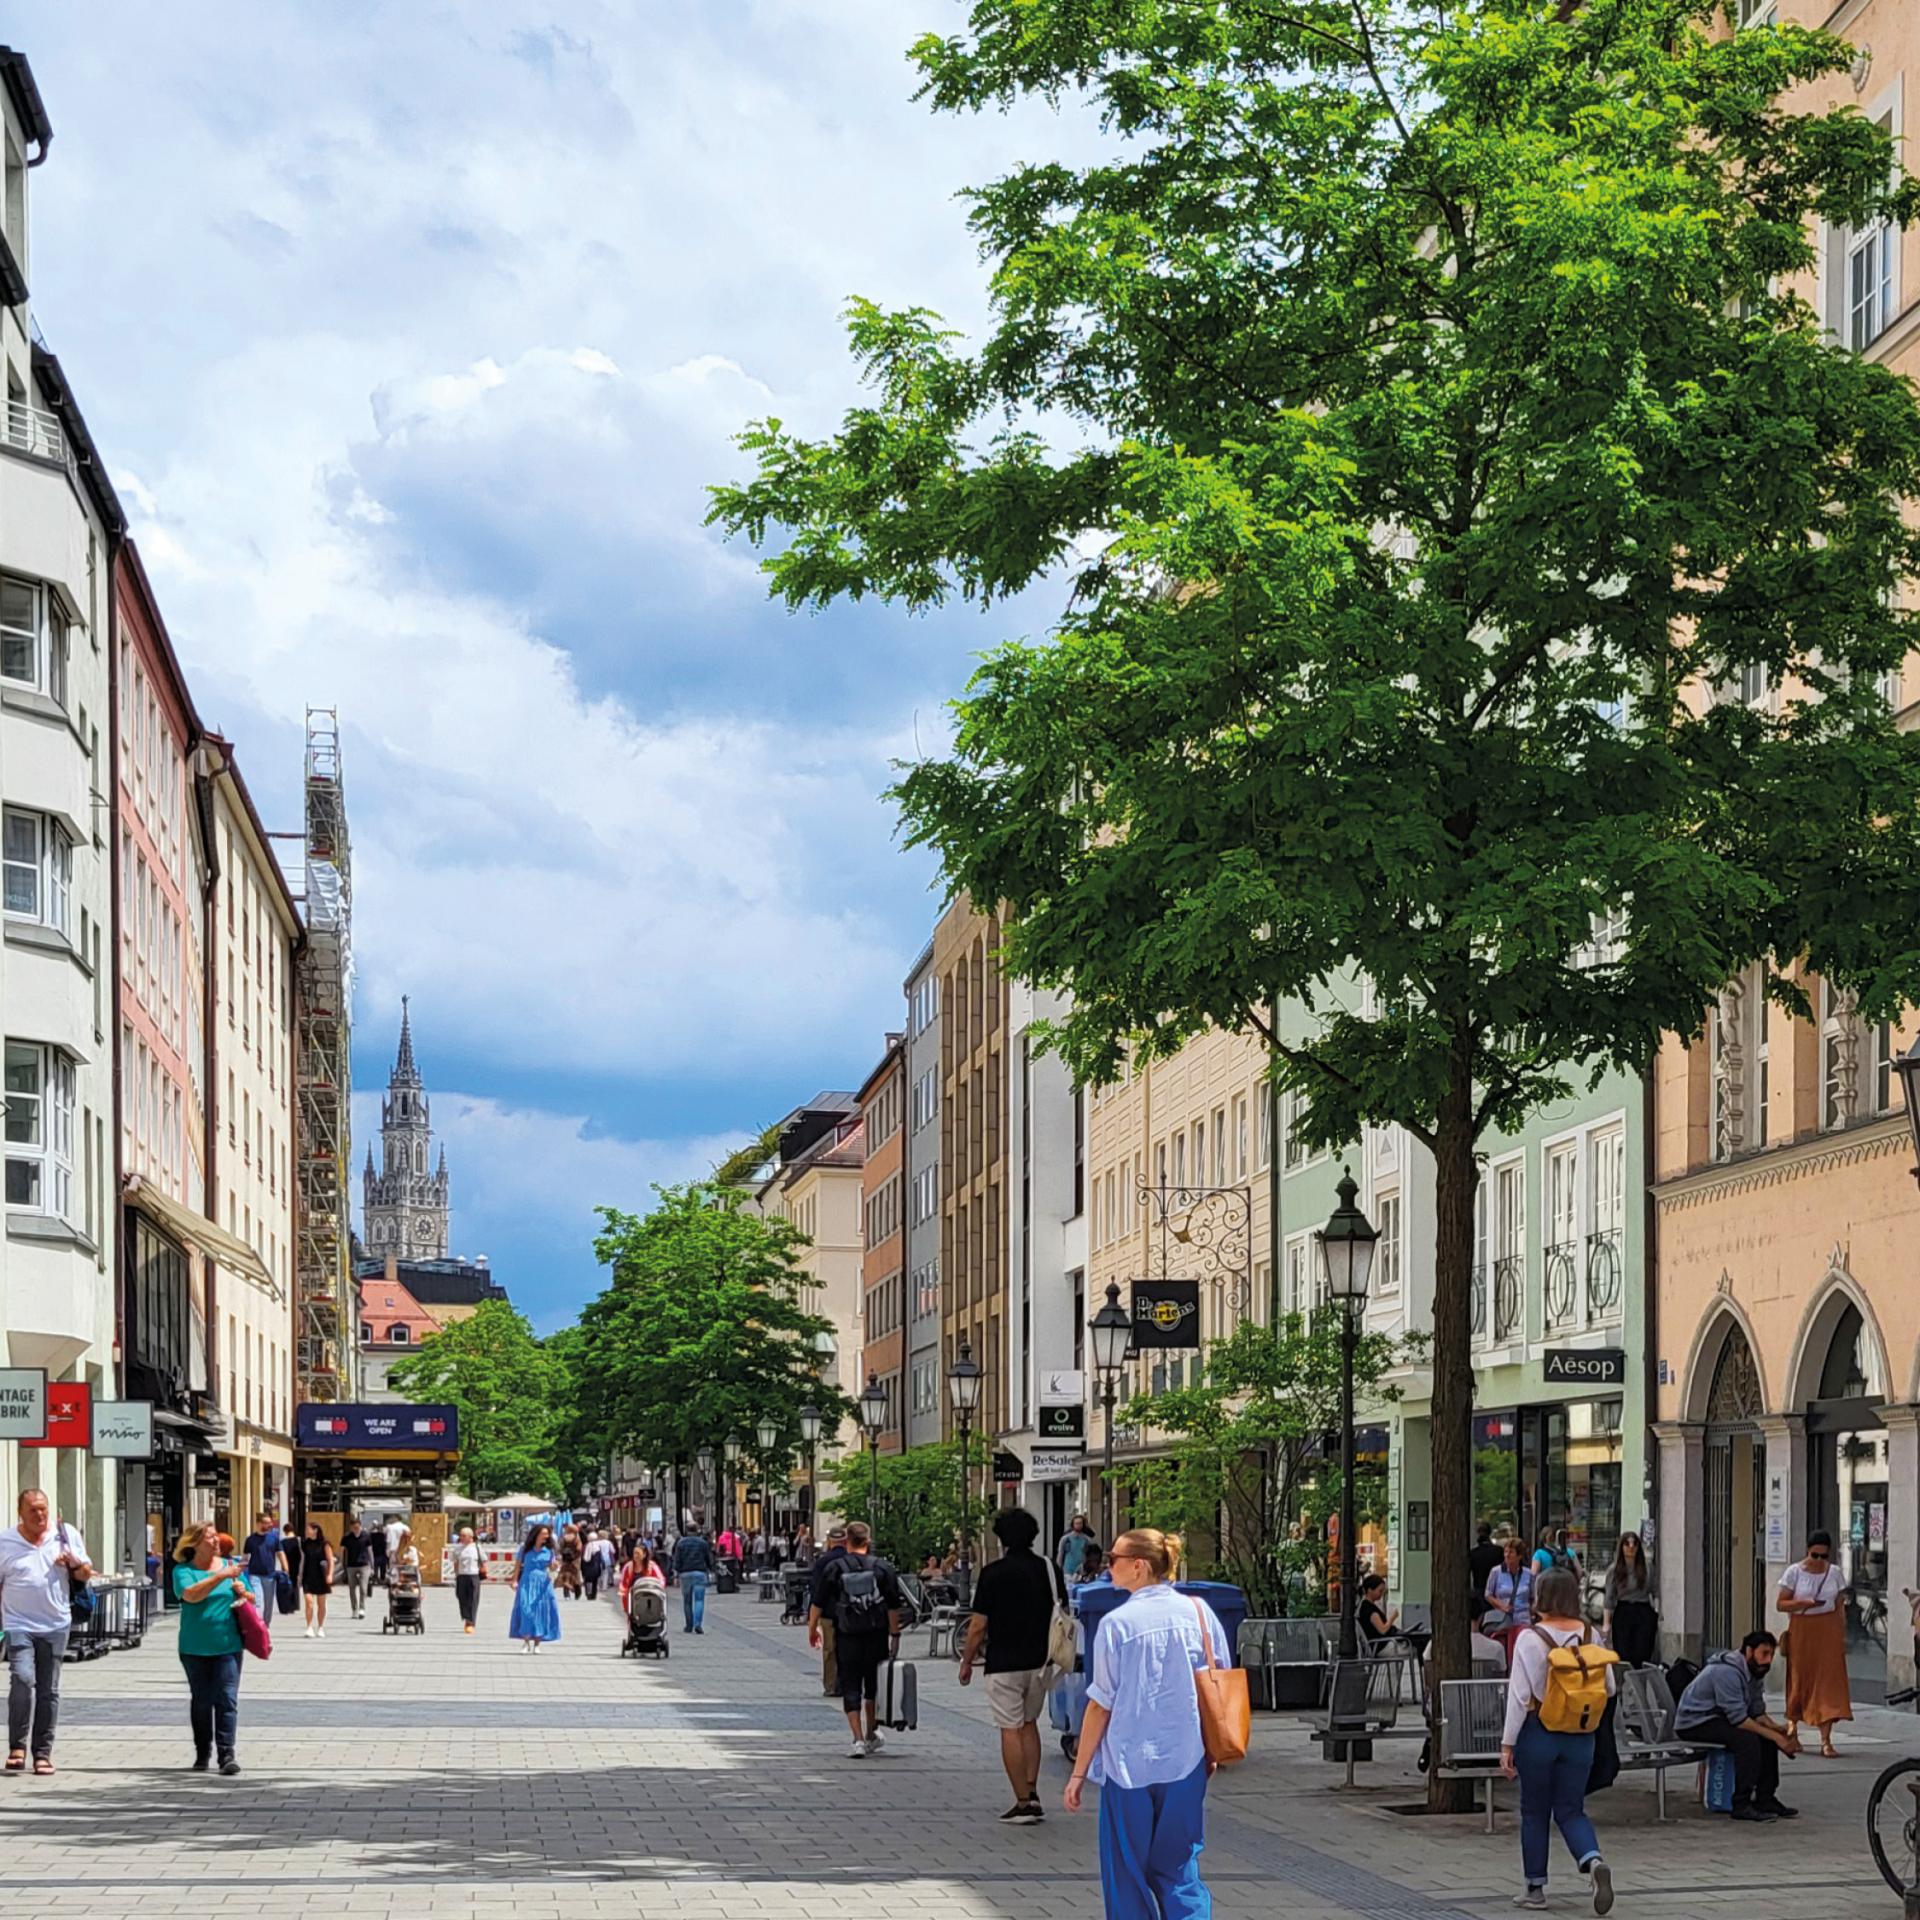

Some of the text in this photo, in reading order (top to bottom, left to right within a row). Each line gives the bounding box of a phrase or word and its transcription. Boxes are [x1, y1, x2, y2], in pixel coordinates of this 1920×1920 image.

[1137, 1302, 1196, 1320] Martens
[364, 1419, 396, 1427] WE ARE
[368, 1427, 392, 1435] OPEN
[1048, 1424, 1075, 1432] evolve
